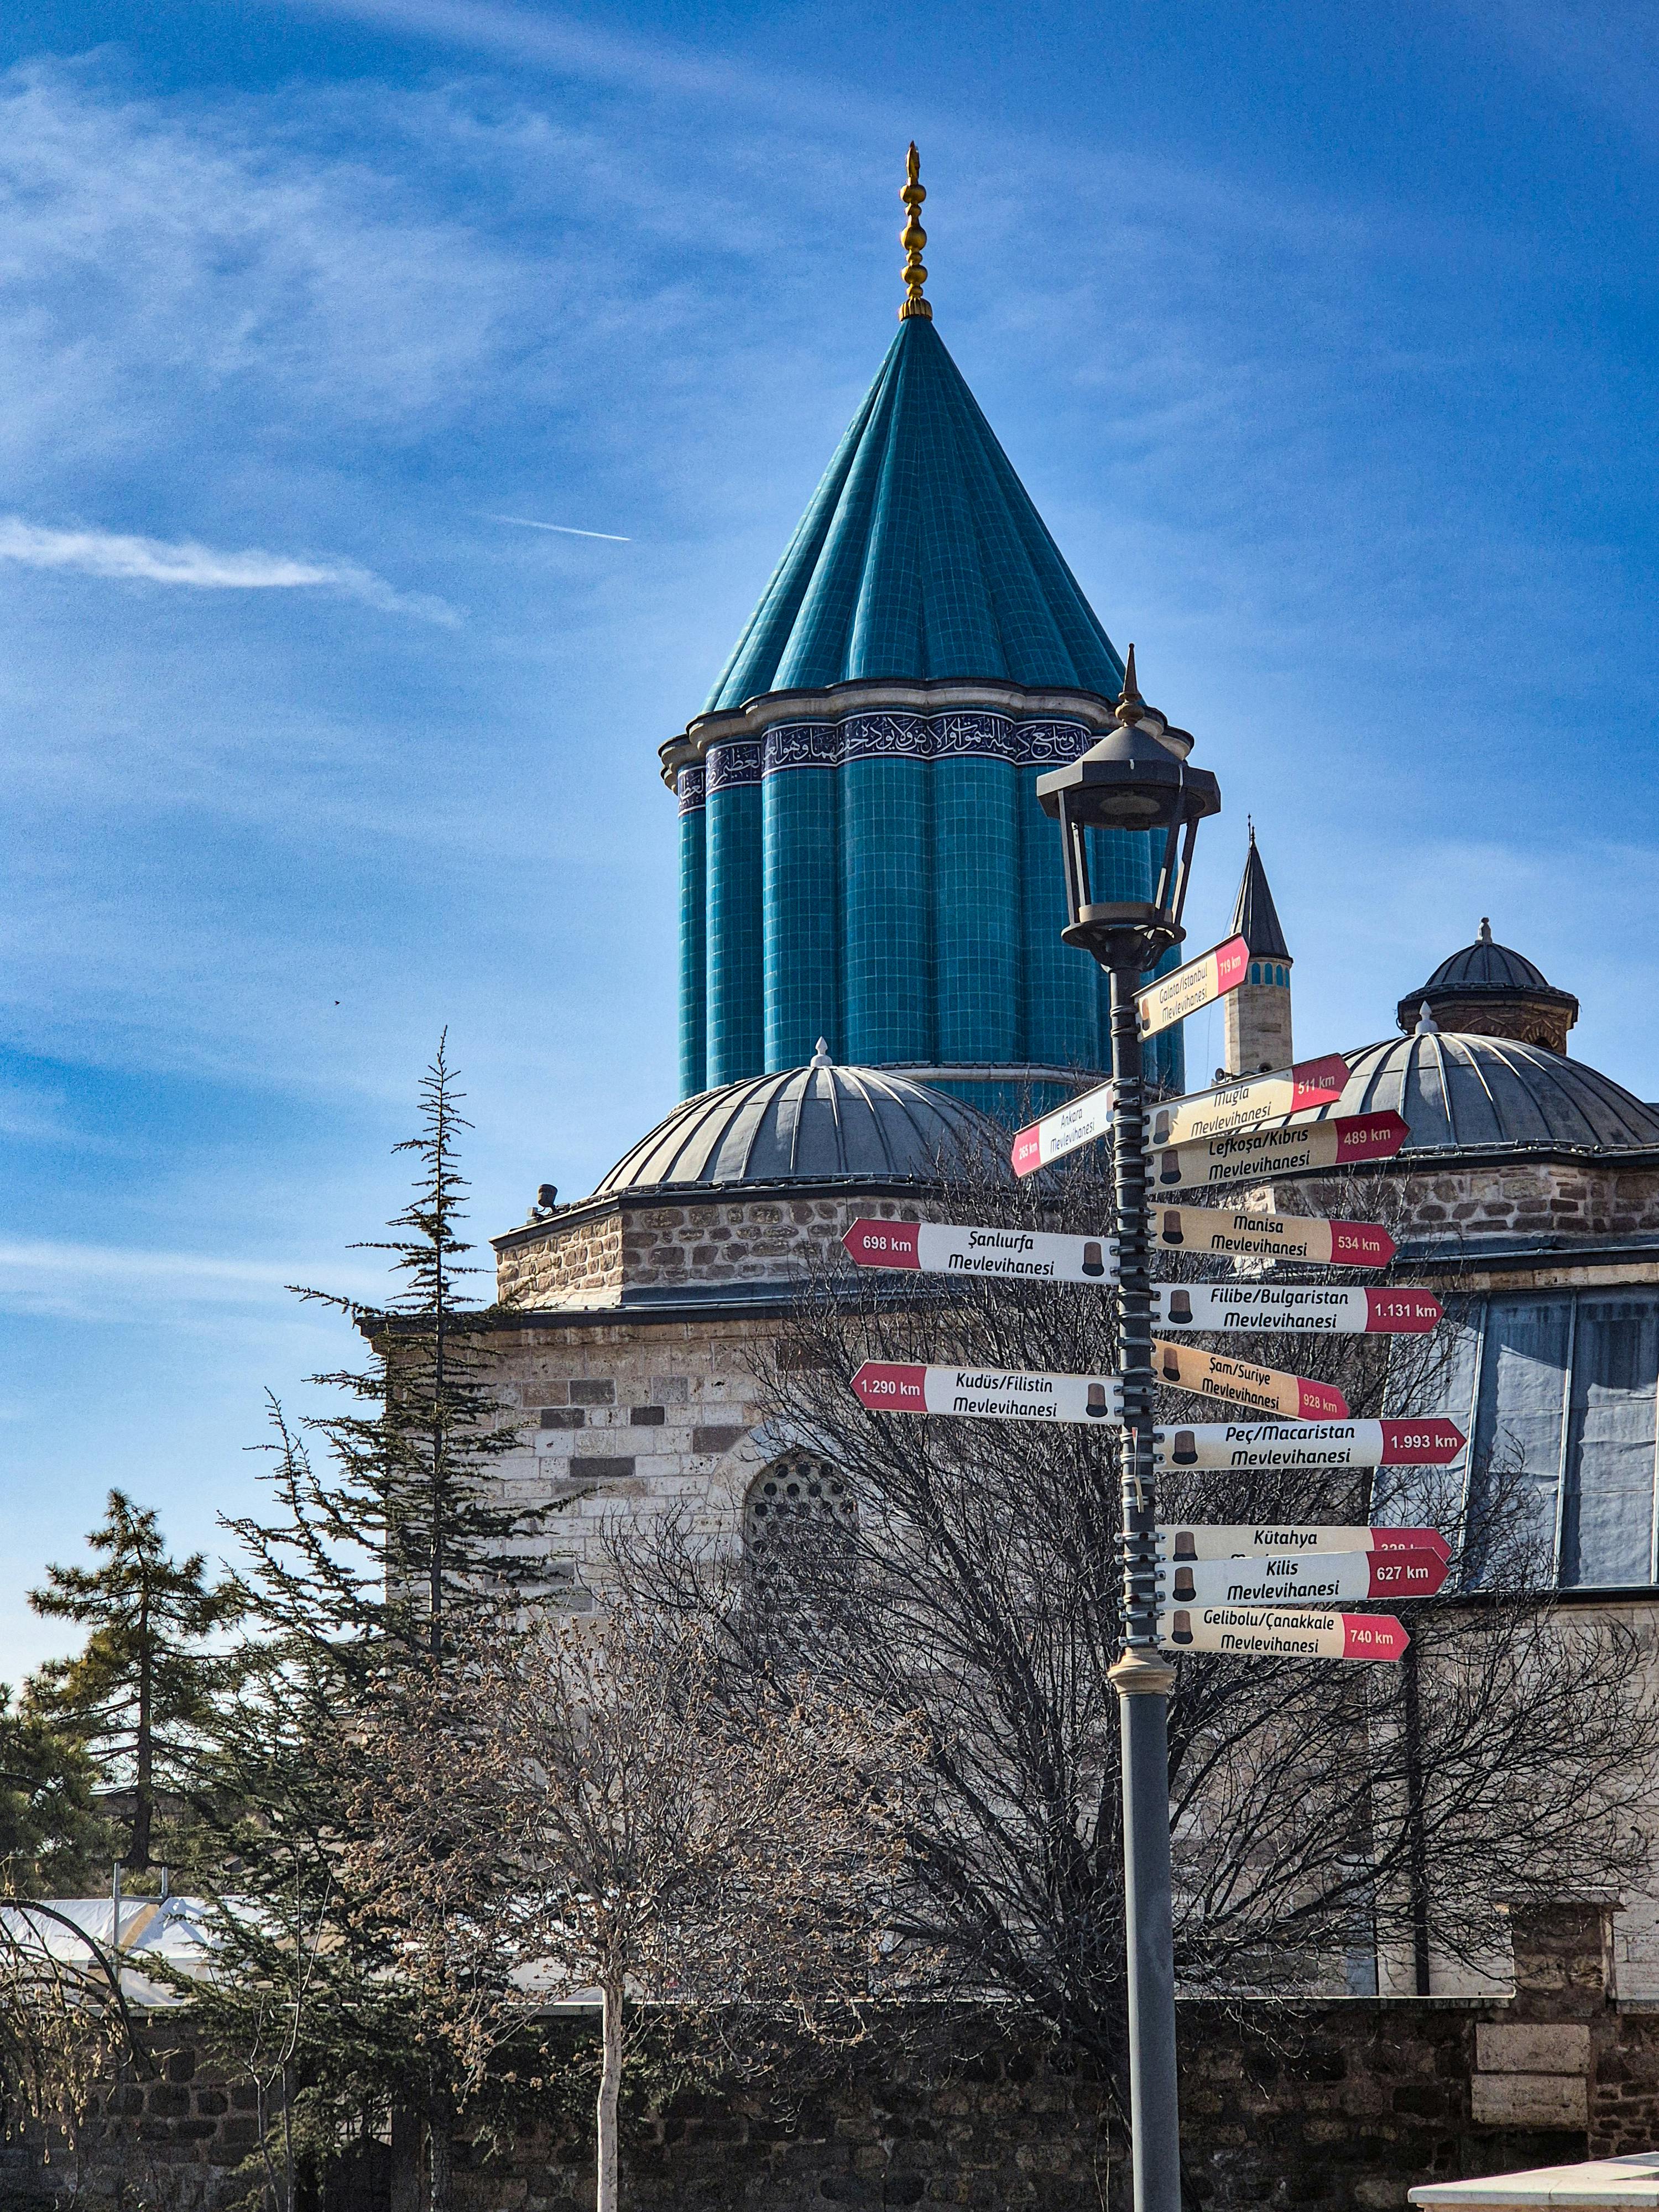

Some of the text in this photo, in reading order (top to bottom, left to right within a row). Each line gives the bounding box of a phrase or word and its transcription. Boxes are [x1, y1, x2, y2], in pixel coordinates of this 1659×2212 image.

[1219, 955, 1241, 977] 719 km
[1159, 962, 1208, 1004] Galata/İstanbul
[1162, 983, 1207, 1023] Mevlevihanesi
[1214, 1085, 1249, 1107] Muğla
[1297, 1076, 1335, 1095] 511 km
[1060, 1108, 1083, 1129] Ankara
[1191, 1101, 1271, 1138] Mevlevihanesi
[1050, 1117, 1095, 1154] Mevlevihanesi
[1209, 1129, 1309, 1158] Lefkoşa/Kıbrıs
[1344, 1128, 1391, 1145] 489 km
[1019, 1142, 1038, 1160] 265 km
[1209, 1150, 1311, 1180] Mevlevihanesi
[1233, 1215, 1284, 1234] Manisa
[863, 1235, 912, 1253] 698 km
[968, 1230, 1034, 1253] Şanlıurfa
[1211, 1234, 1308, 1257] Mevlevihanesi
[1337, 1235, 1380, 1252] 534 km
[948, 1254, 1055, 1276] Mevlevihanesi
[1210, 1287, 1349, 1308] Filibe/Bulgaristan
[1224, 1312, 1338, 1328] Mevlevihanesi
[1375, 1303, 1437, 1318] 1.131 km
[1208, 1357, 1271, 1386] Şam/Suriye
[861, 1379, 921, 1397] 1.290 km
[956, 1372, 1053, 1393] Kudüs/Filistin
[1202, 1378, 1280, 1410] Mevlevihanesi
[1303, 1393, 1338, 1413] 928 km
[953, 1397, 1057, 1418] Mevlevihanesi
[1225, 1425, 1355, 1444] Peç/Macaristan
[1391, 1434, 1458, 1449] 1.993 km
[1230, 1448, 1352, 1466] Mevlevihanesi
[1254, 1530, 1318, 1549] Kütahya
[1266, 1560, 1299, 1576] Kilis
[1376, 1565, 1429, 1580] 627 km
[1227, 1580, 1340, 1601] Mevlevihanesi
[1203, 1609, 1334, 1631] Gelibolu/Çanakkale
[1220, 1634, 1319, 1653] Mevlevihanesi
[1350, 1629, 1394, 1645] 740 km
